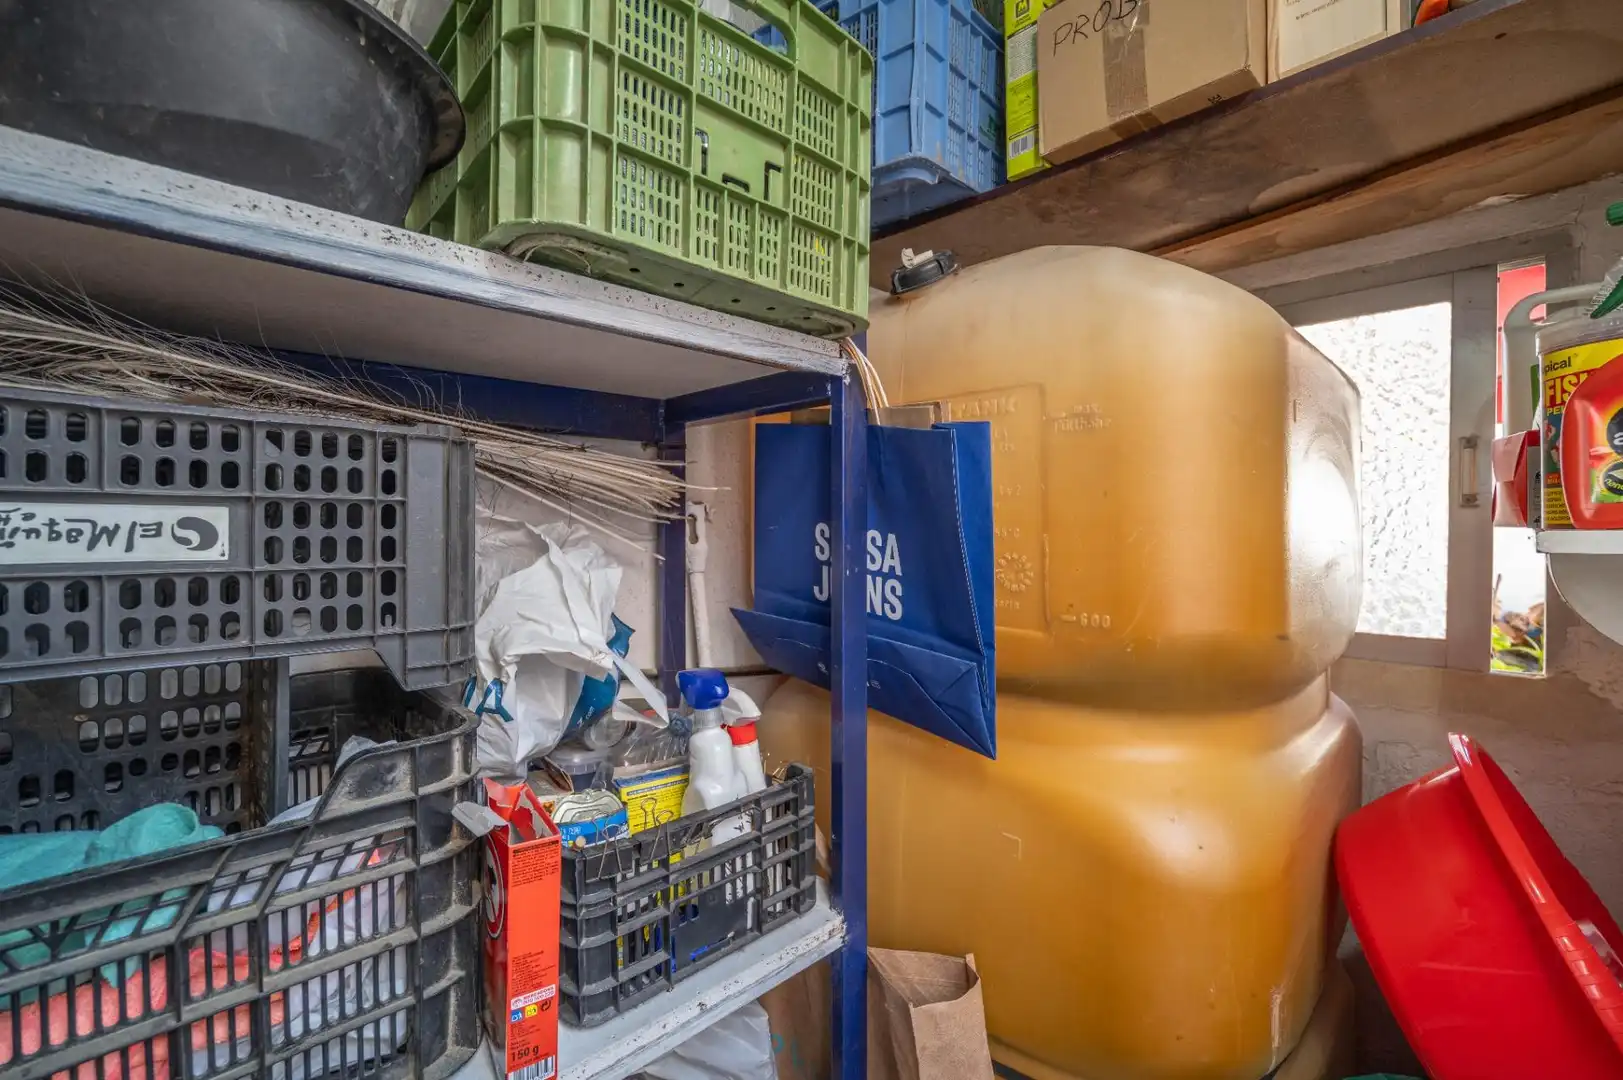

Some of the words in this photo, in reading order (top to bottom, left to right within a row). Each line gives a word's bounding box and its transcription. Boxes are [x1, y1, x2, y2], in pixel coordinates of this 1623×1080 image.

[1545, 372, 1588, 408] FIS
[814, 522, 903, 577] SSA
[813, 565, 902, 621] JNS
